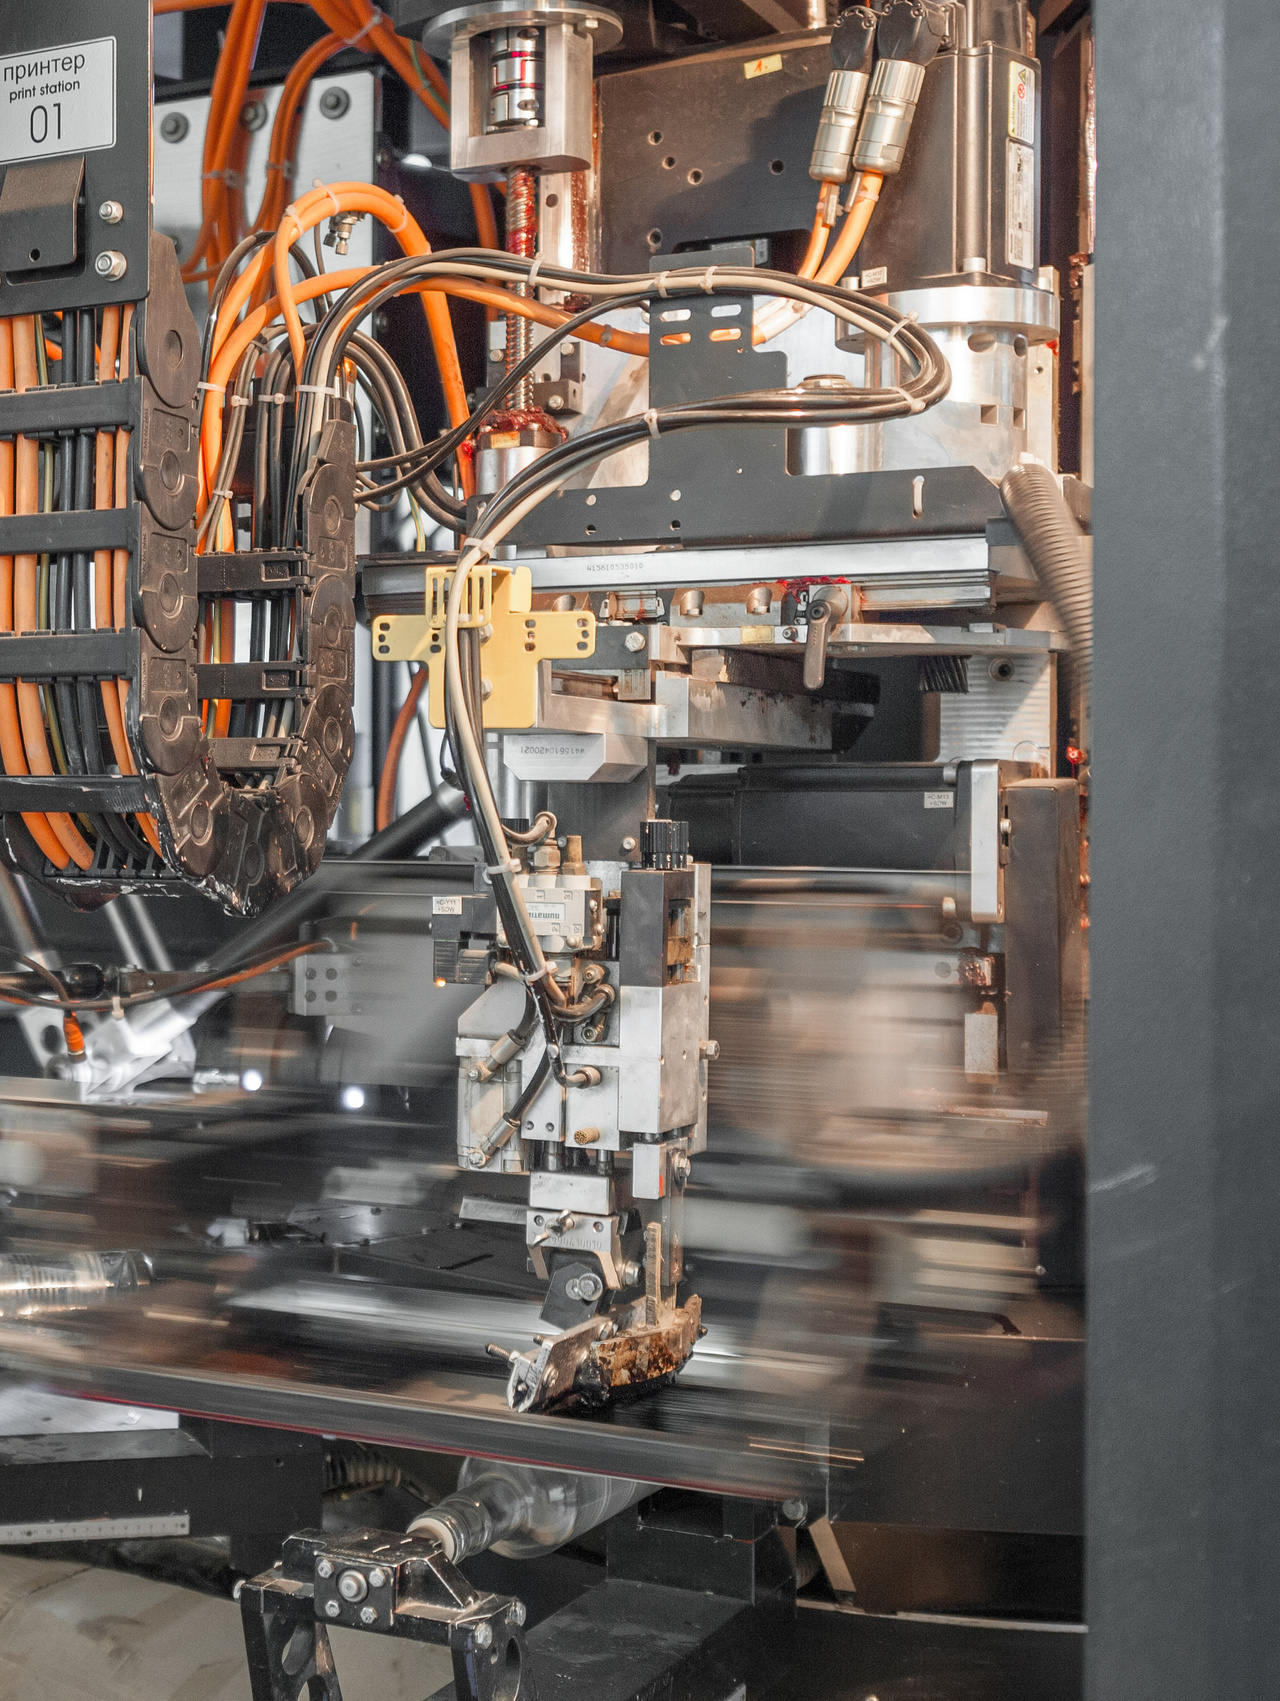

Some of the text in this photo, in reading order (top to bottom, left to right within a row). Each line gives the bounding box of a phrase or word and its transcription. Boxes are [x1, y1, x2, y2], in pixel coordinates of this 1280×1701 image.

[3, 54, 86, 84] принтер
[9, 80, 80, 103] print station
[30, 102, 61, 144] 01
